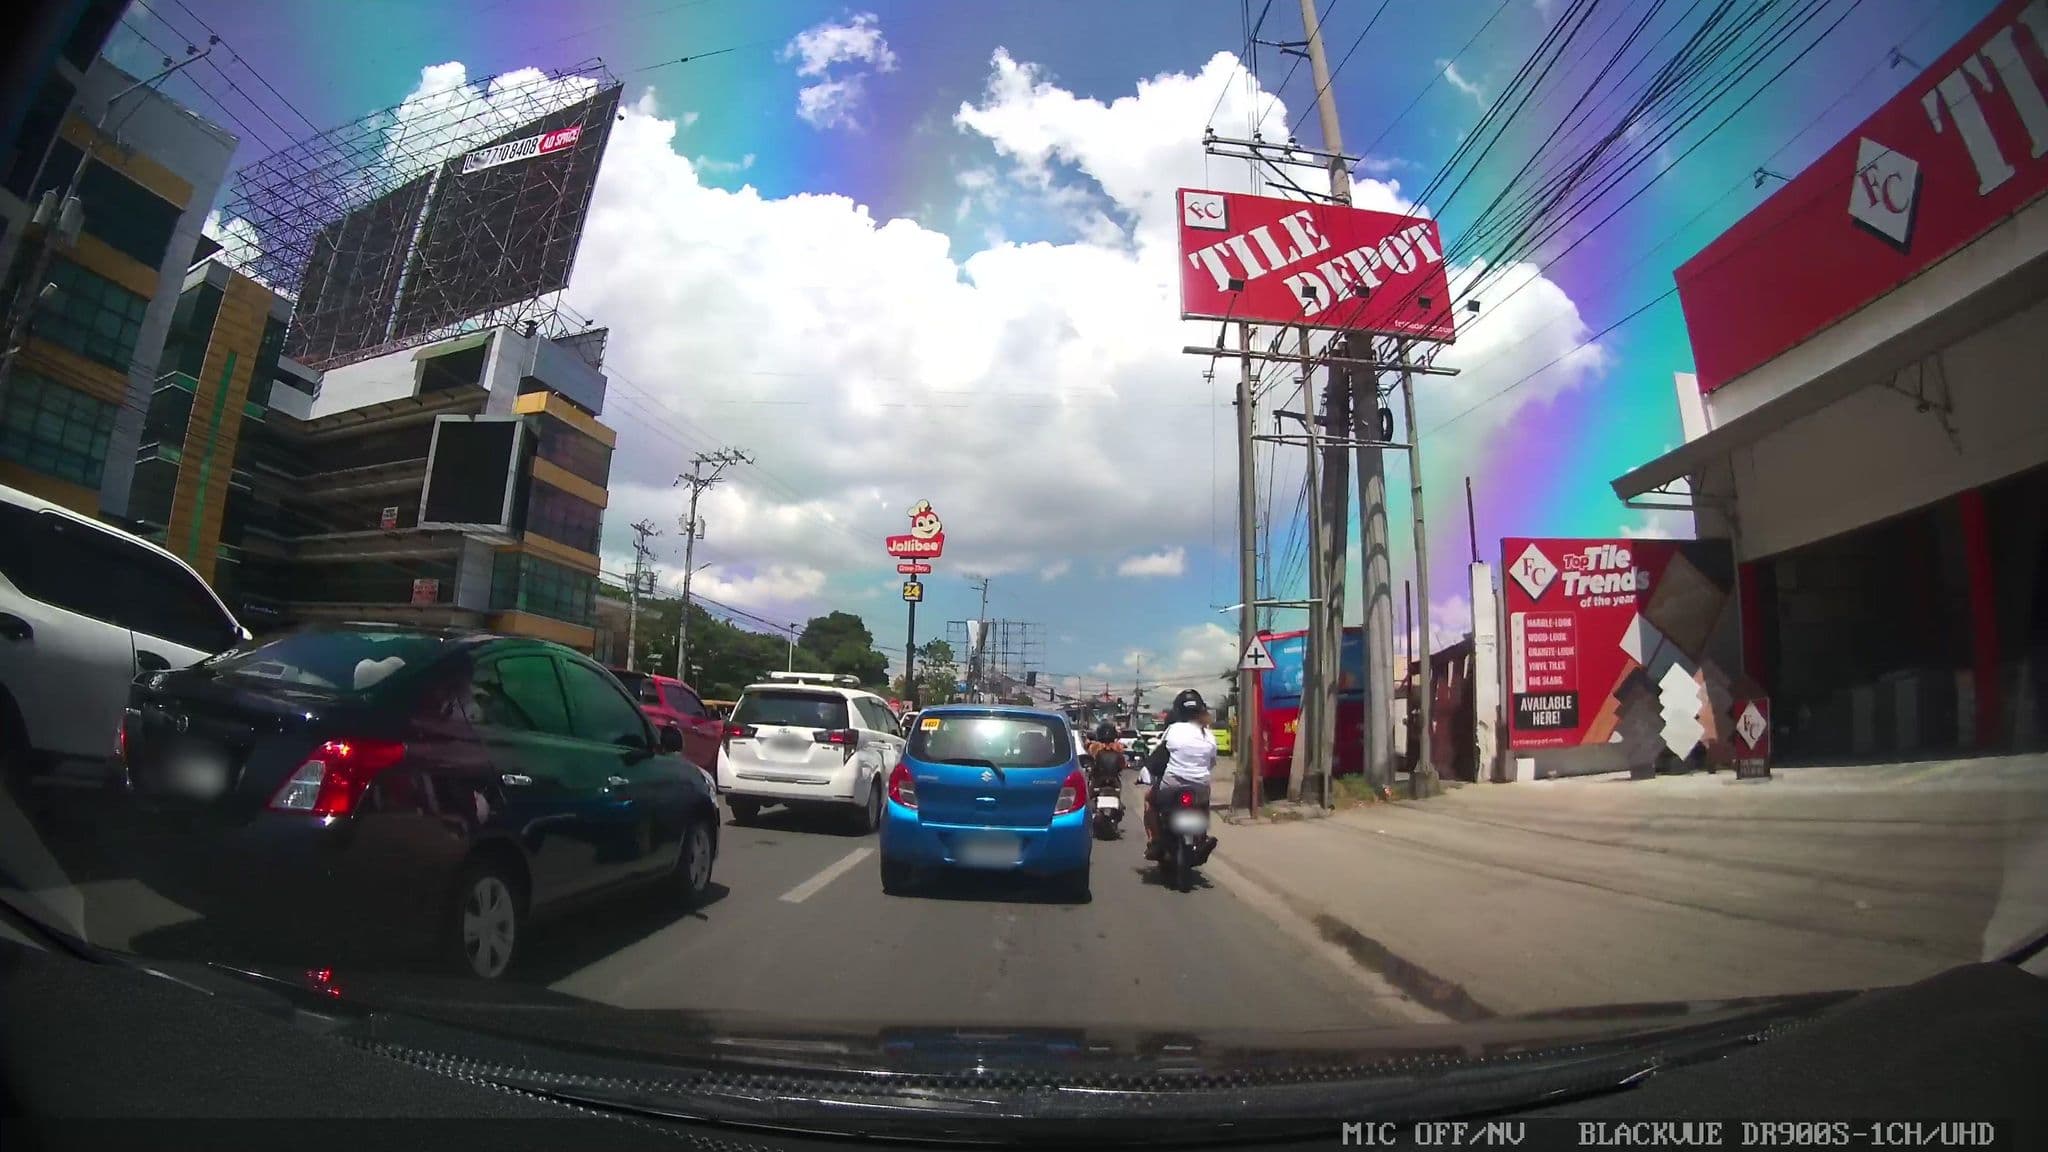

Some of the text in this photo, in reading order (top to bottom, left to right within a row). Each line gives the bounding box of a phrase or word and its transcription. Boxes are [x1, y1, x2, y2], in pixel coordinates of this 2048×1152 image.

[1921, 0, 2048, 196] TI
[1859, 163, 1909, 213] FC
[1187, 201, 1223, 219] FC
[1188, 210, 1330, 292] TILE
[1283, 223, 1441, 317] DEPOT
[888, 539, 939, 552] Jollibee
[1563, 544, 1631, 571] Top Tile
[1522, 557, 1546, 587] FC
[1562, 566, 1649, 596] Trends
[903, 586, 920, 596] 24
[1580, 595, 1636, 608] of the year
[1520, 695, 1572, 711] AVAILABLE
[1532, 711, 1560, 726] HERE!
